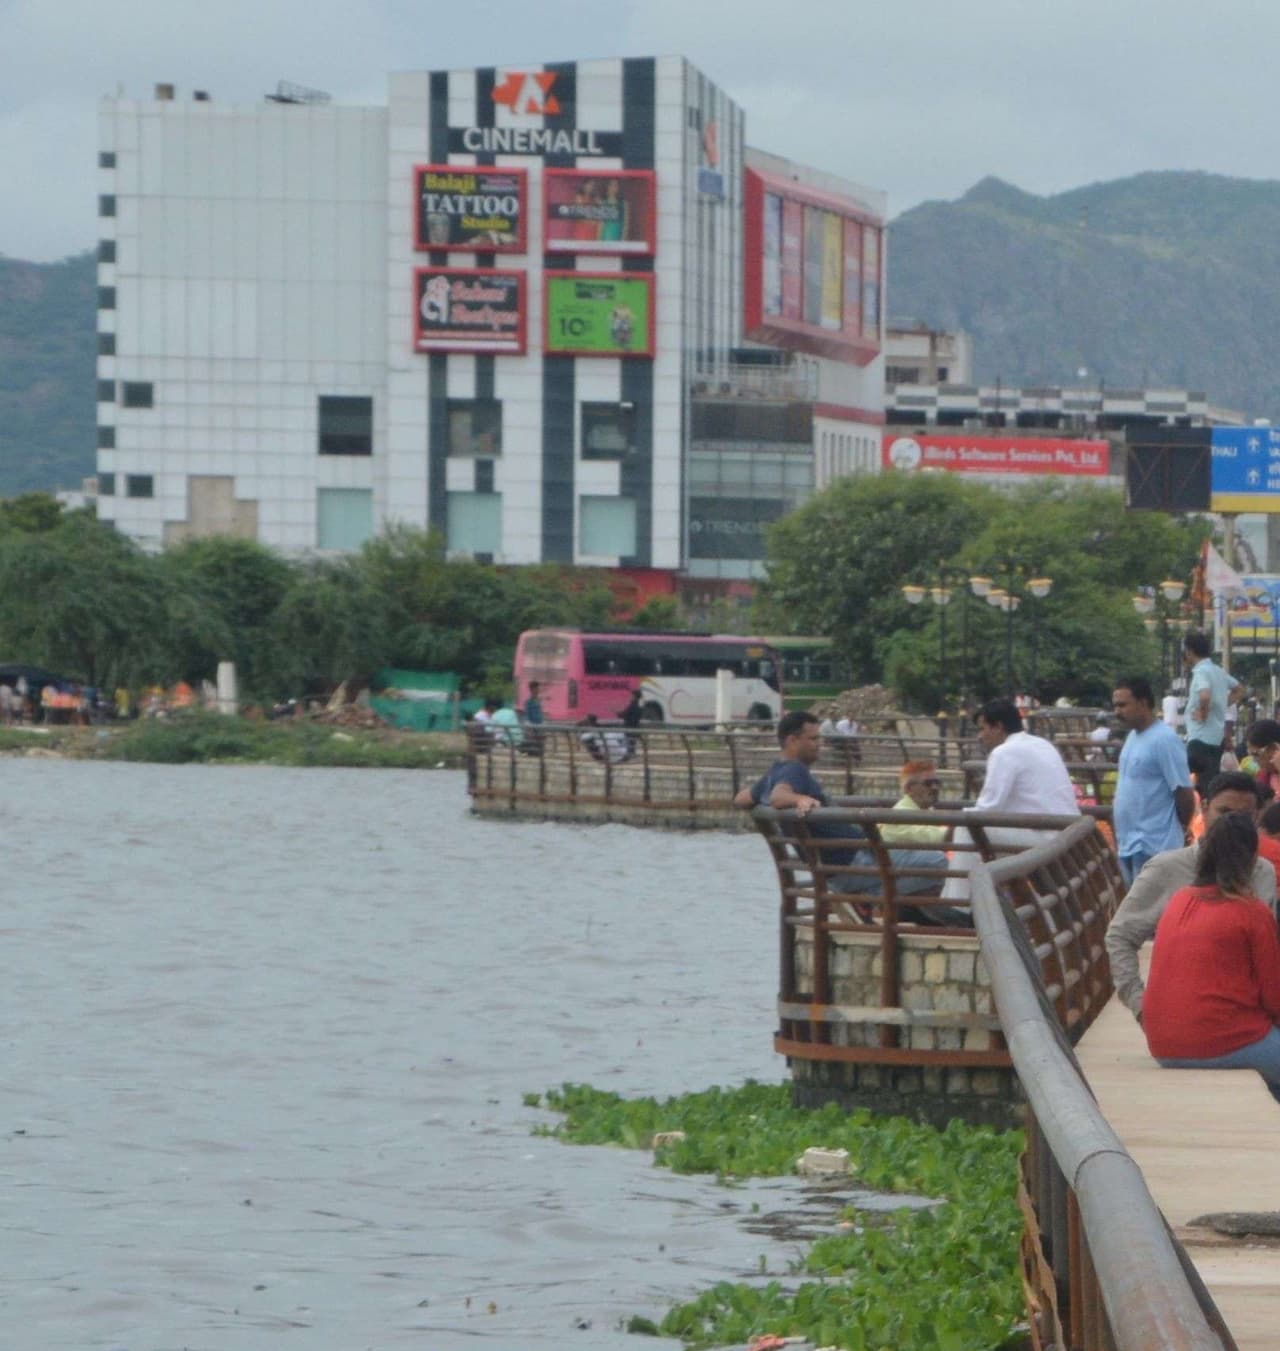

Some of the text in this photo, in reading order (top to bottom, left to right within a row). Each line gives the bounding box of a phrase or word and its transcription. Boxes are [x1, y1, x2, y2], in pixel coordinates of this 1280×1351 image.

[463, 127, 603, 154] CINEMALL
[422, 194, 519, 216] TATTOO
[462, 215, 511, 230] Studio
